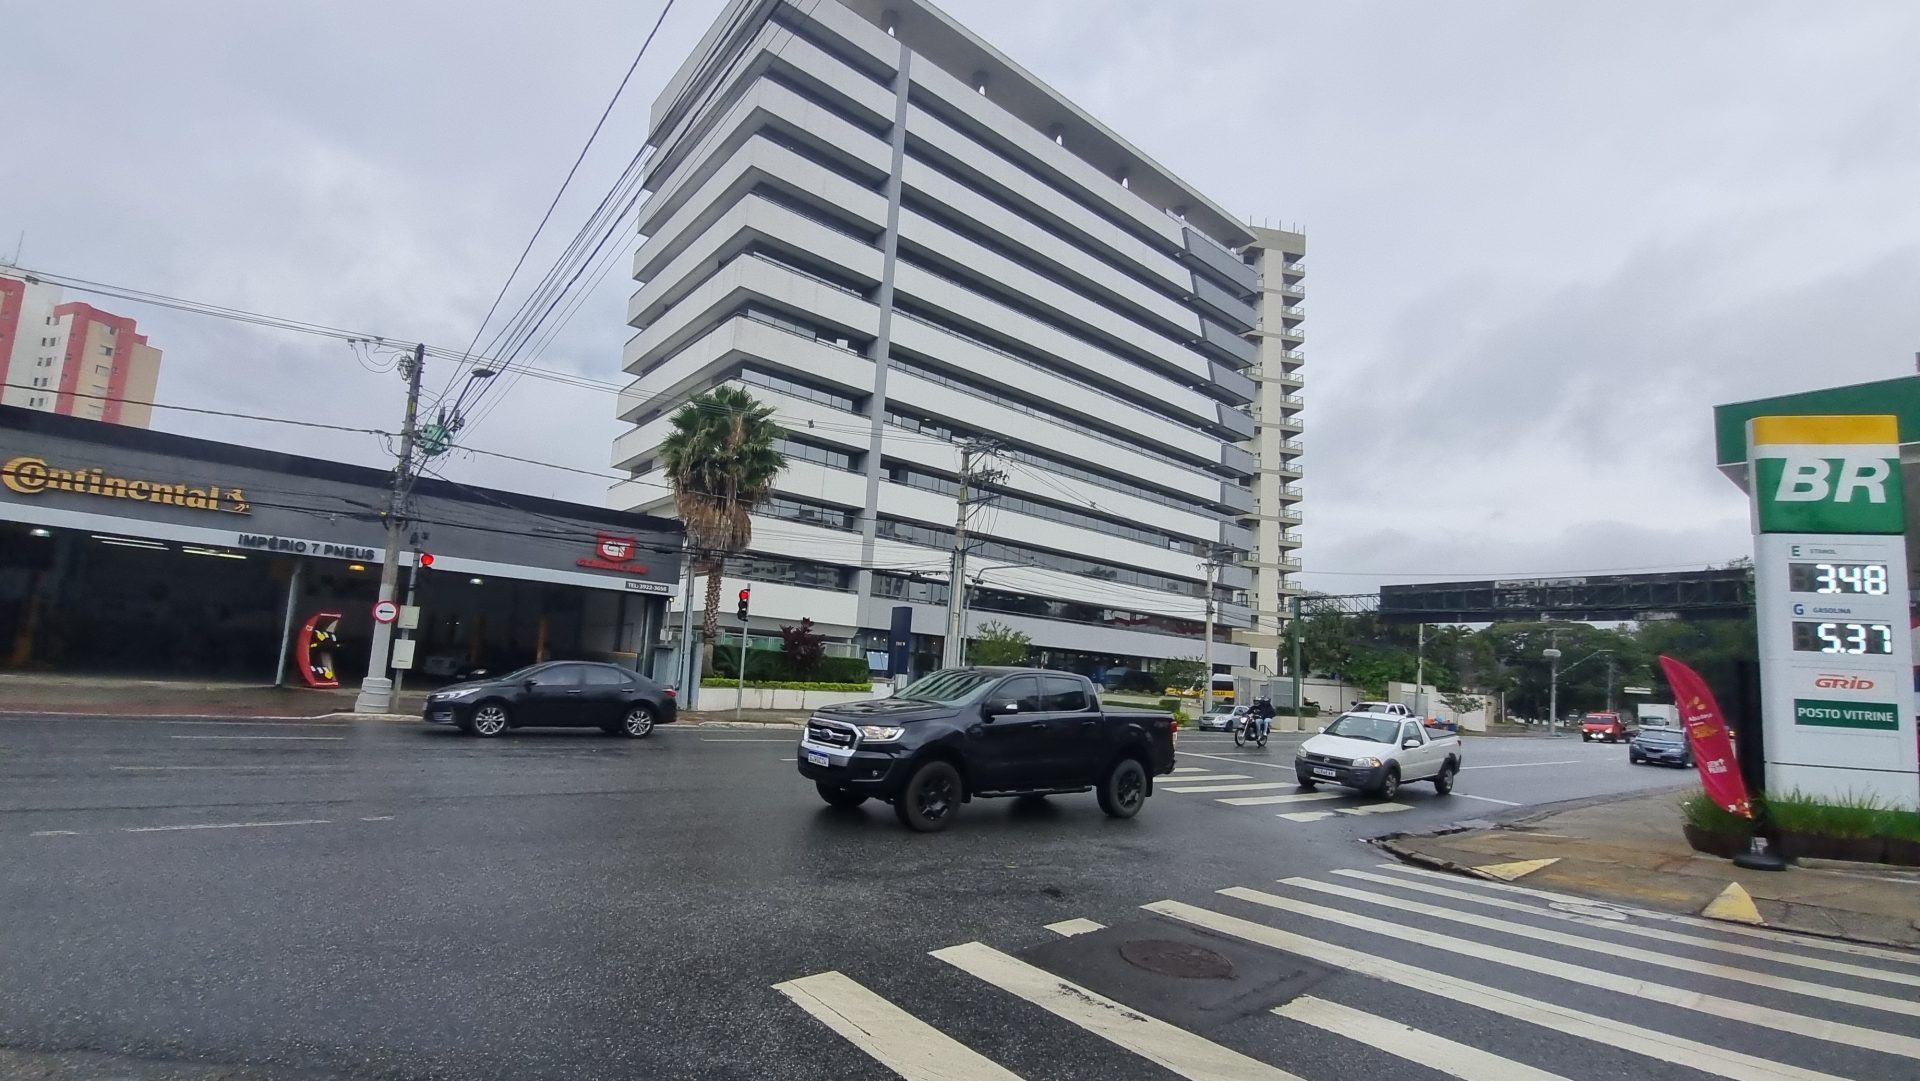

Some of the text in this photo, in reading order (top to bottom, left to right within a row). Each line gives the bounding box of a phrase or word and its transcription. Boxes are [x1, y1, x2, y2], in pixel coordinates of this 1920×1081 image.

[1, 456, 220, 511] Continental
[1775, 457, 1890, 503] BR
[238, 534, 375, 561] IMPÉRIO 7 PNEUS
[1791, 545, 1800, 556] E
[1816, 564, 1887, 595] 3.48
[1793, 603, 1804, 615] G
[1817, 623, 1891, 654] 5.37
[1797, 707, 1894, 722] POSTO VITRINE
